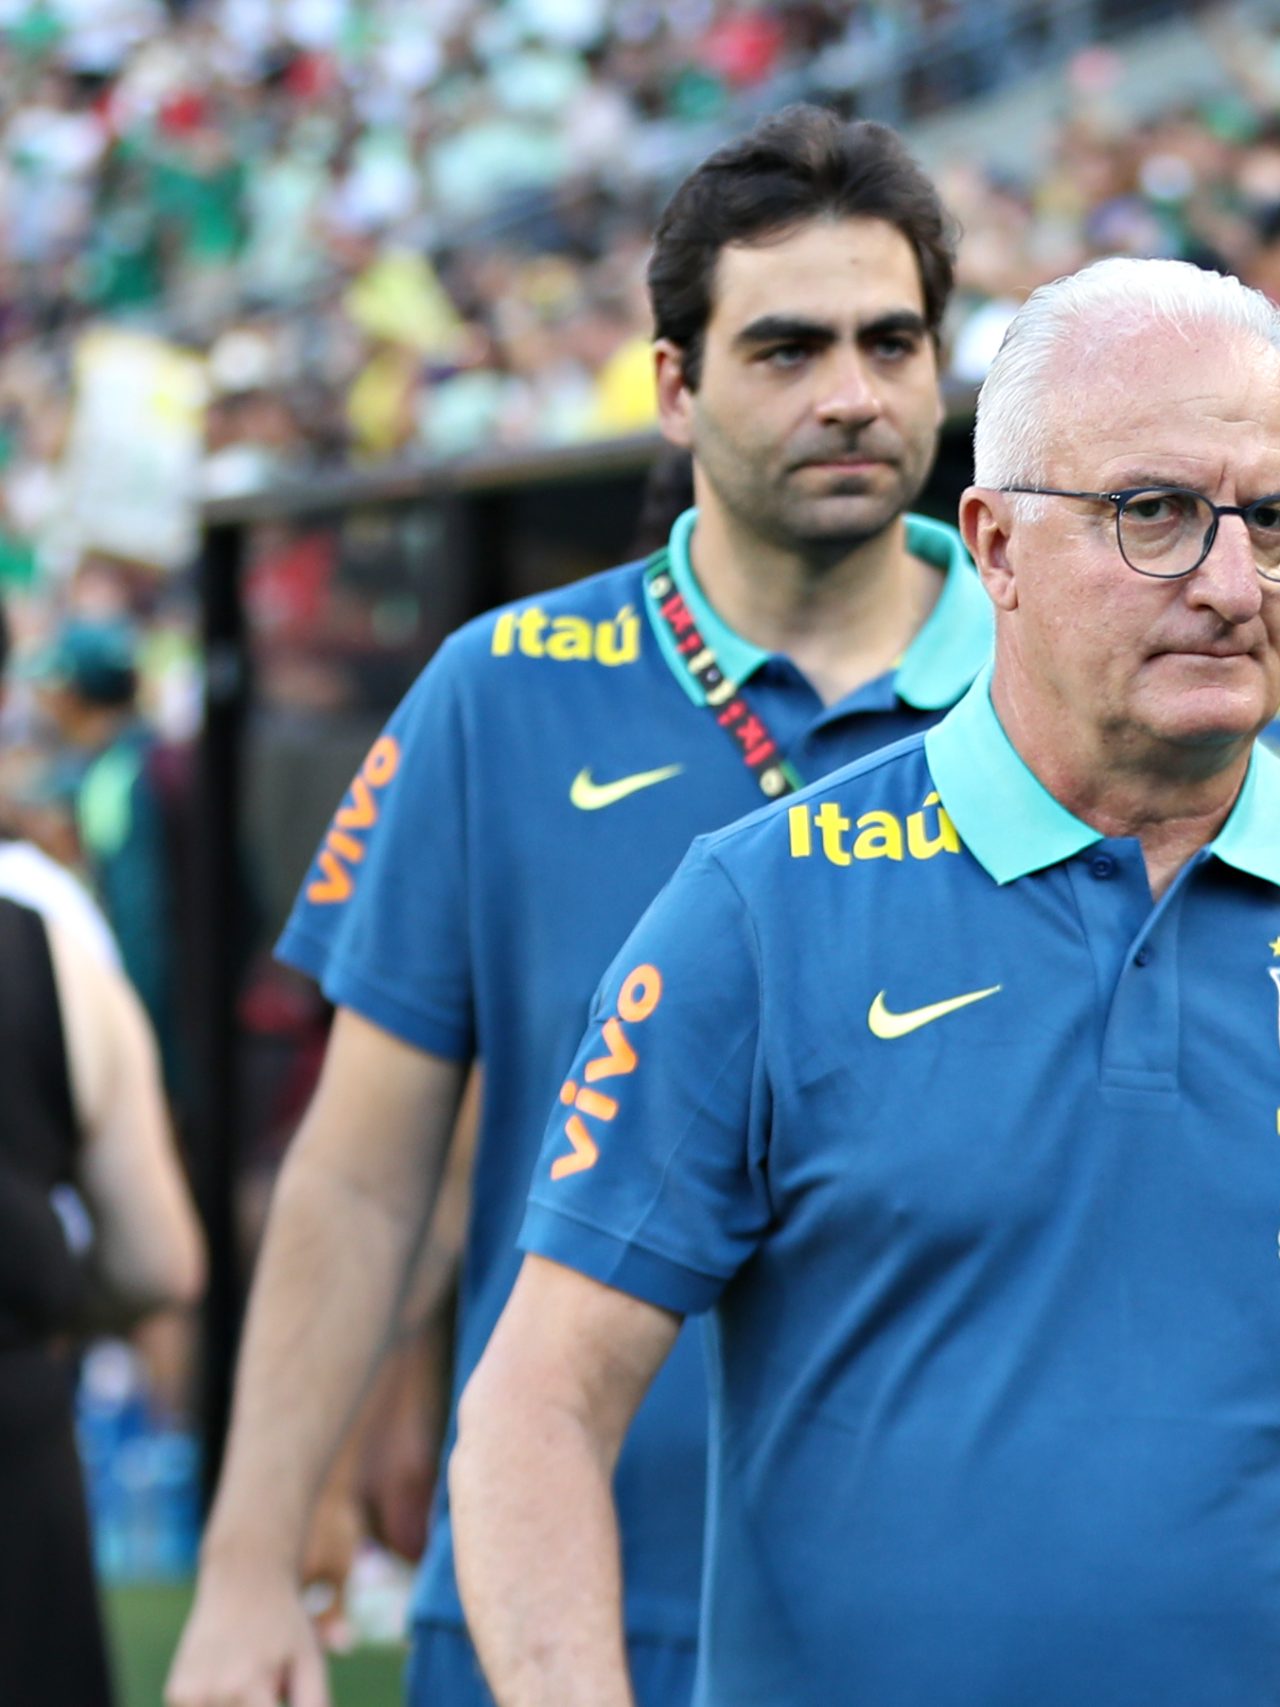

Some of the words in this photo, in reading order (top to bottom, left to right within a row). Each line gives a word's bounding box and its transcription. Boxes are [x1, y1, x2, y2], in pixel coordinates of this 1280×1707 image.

[491, 606, 639, 667] Itaú
[307, 736, 397, 903] vivo
[788, 791, 960, 866] Itaú
[551, 964, 662, 1180] vivo
